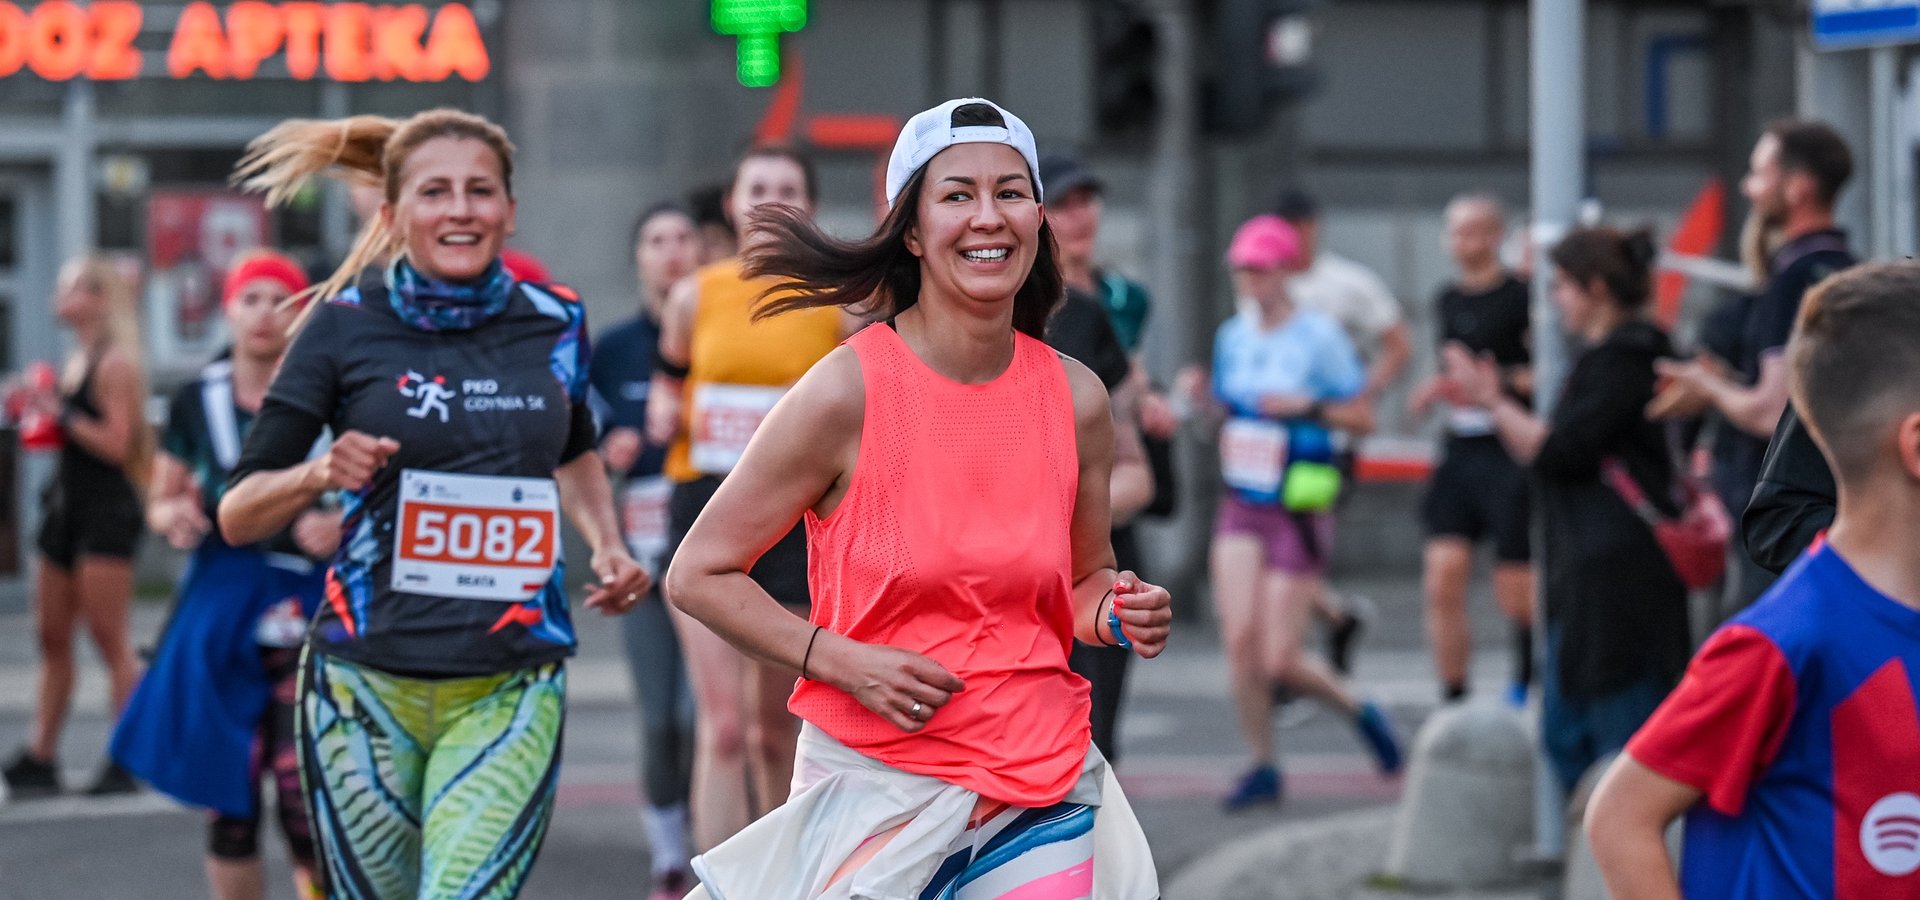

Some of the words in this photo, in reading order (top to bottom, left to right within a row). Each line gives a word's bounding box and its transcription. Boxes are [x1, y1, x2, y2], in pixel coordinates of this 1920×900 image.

[167, 2, 489, 81] APTEKA
[462, 379, 498, 394] PKO
[463, 396, 525, 411] GDYNIA
[413, 511, 545, 562] 5082
[457, 574, 496, 587] BEATA
